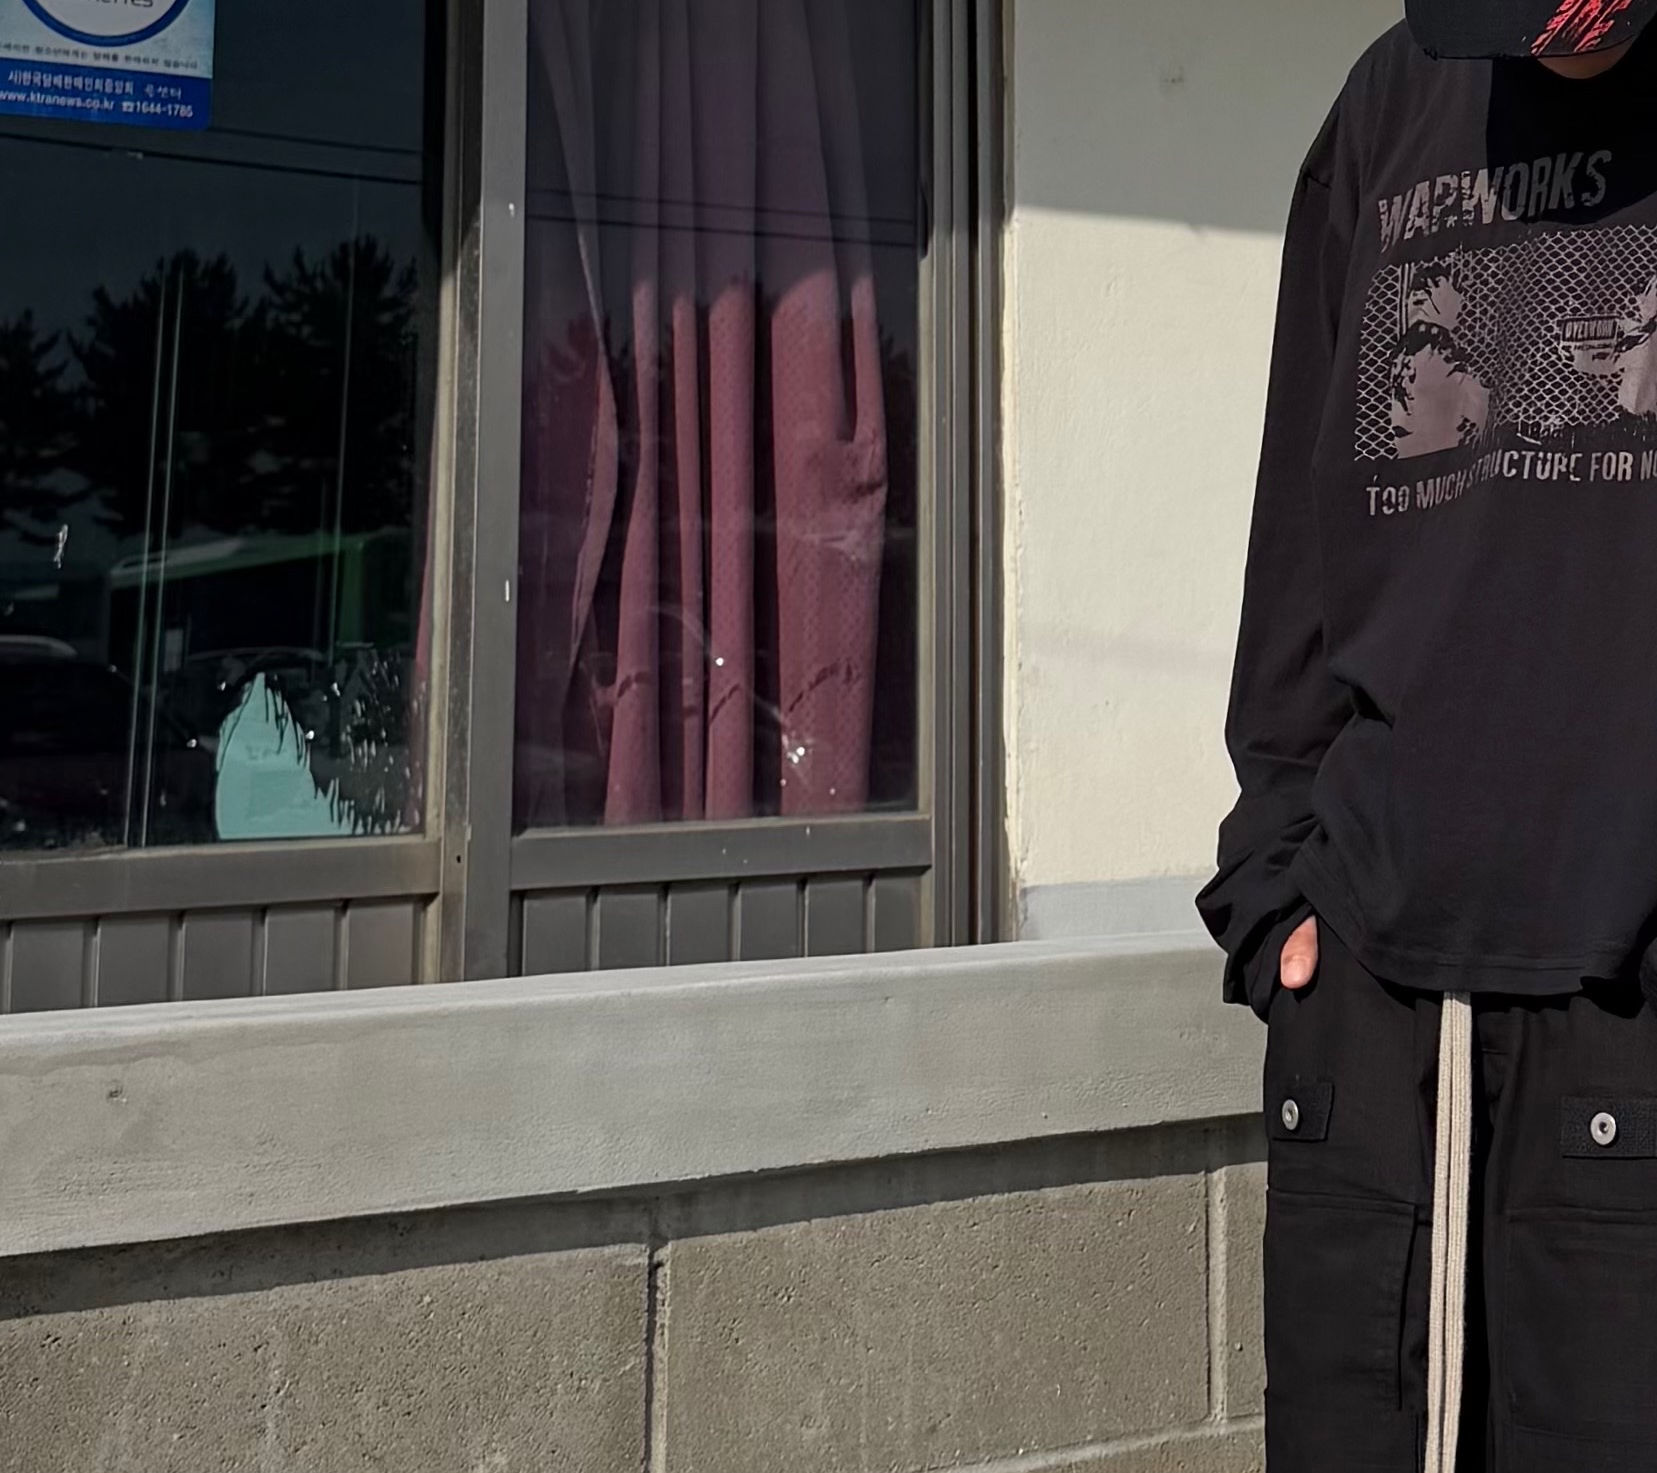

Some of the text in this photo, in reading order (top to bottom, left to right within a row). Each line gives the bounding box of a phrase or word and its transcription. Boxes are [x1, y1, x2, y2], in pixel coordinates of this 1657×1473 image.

[1365, 483, 1410, 516] TOO
[1416, 469, 1467, 510] MUCH
[1589, 450, 1634, 482] FOR
